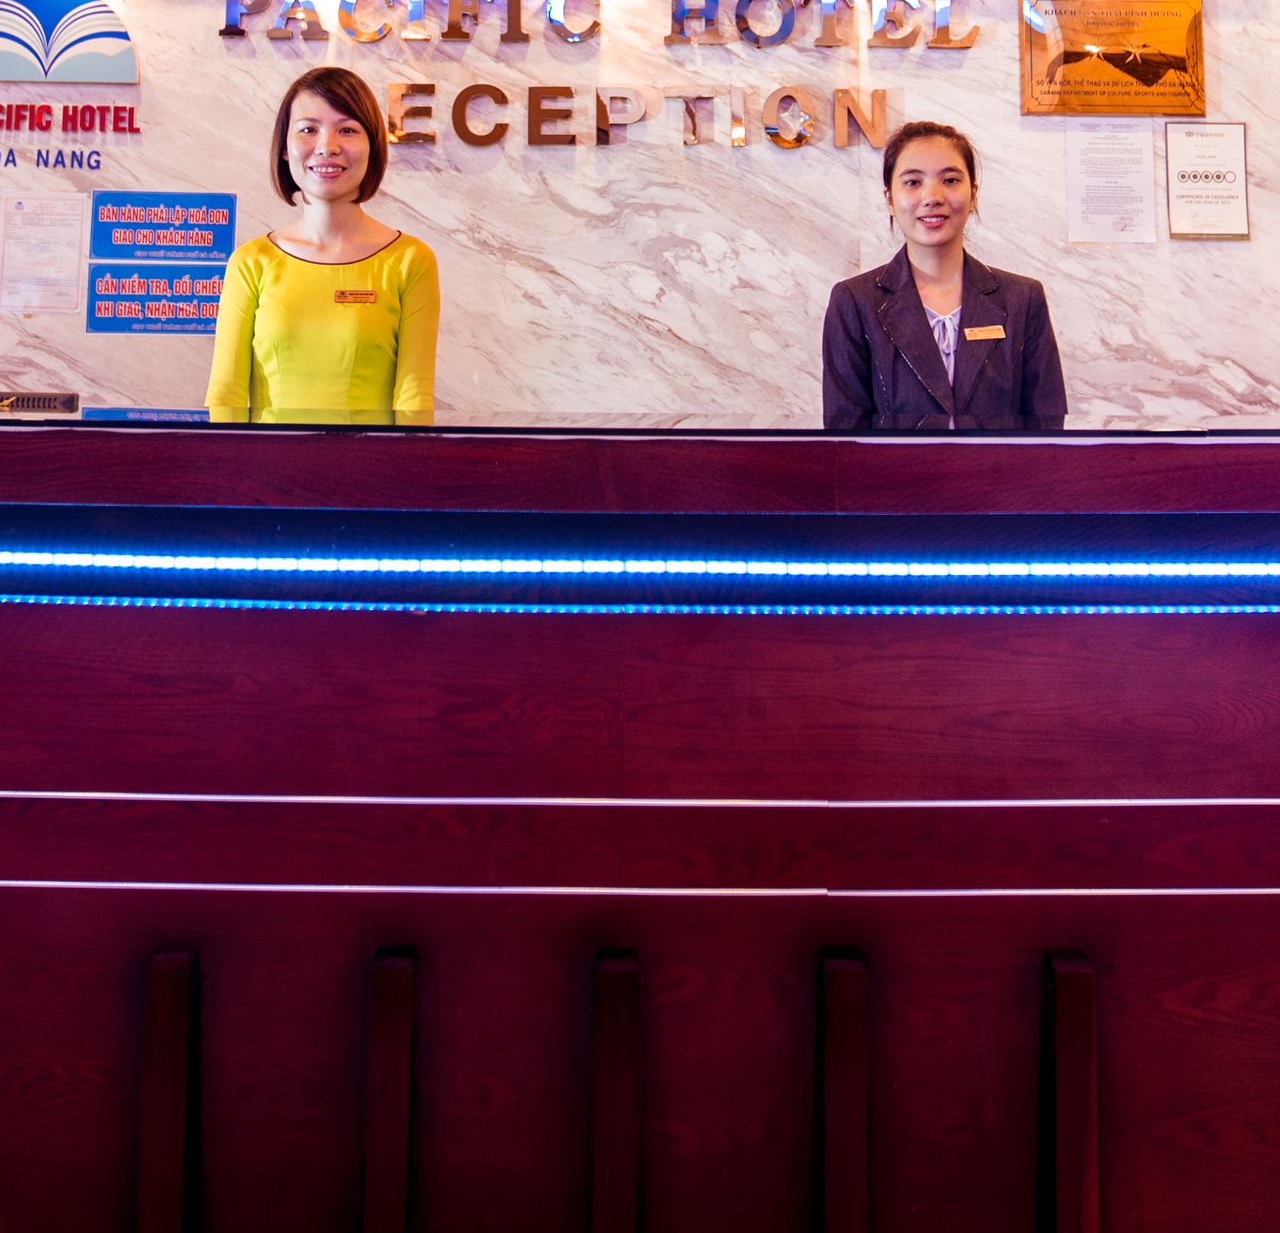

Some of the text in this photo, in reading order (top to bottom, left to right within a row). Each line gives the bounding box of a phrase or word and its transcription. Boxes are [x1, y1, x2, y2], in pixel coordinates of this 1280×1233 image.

[62, 105, 142, 134] HOTEL
[386, 83, 887, 150] ECEPTION
[36, 149, 102, 169] NANG
[120, 204, 144, 223] HÀNG
[145, 204, 168, 223] PHẢI
[169, 205, 187, 226] LẬP
[188, 206, 207, 224] HOÁ
[209, 207, 229, 224] ĐƠN
[112, 226, 213, 246] GIAO CHO KHÁCH HÀNG
[96, 273, 118, 295] CẦN
[120, 273, 147, 295] KIỂM
[149, 278, 172, 297] TRA,
[174, 274, 192, 296] ĐỐI
[95, 301, 114, 317] KHI
[116, 302, 143, 319] GIAO,
[145, 299, 175, 321] NHẬN
